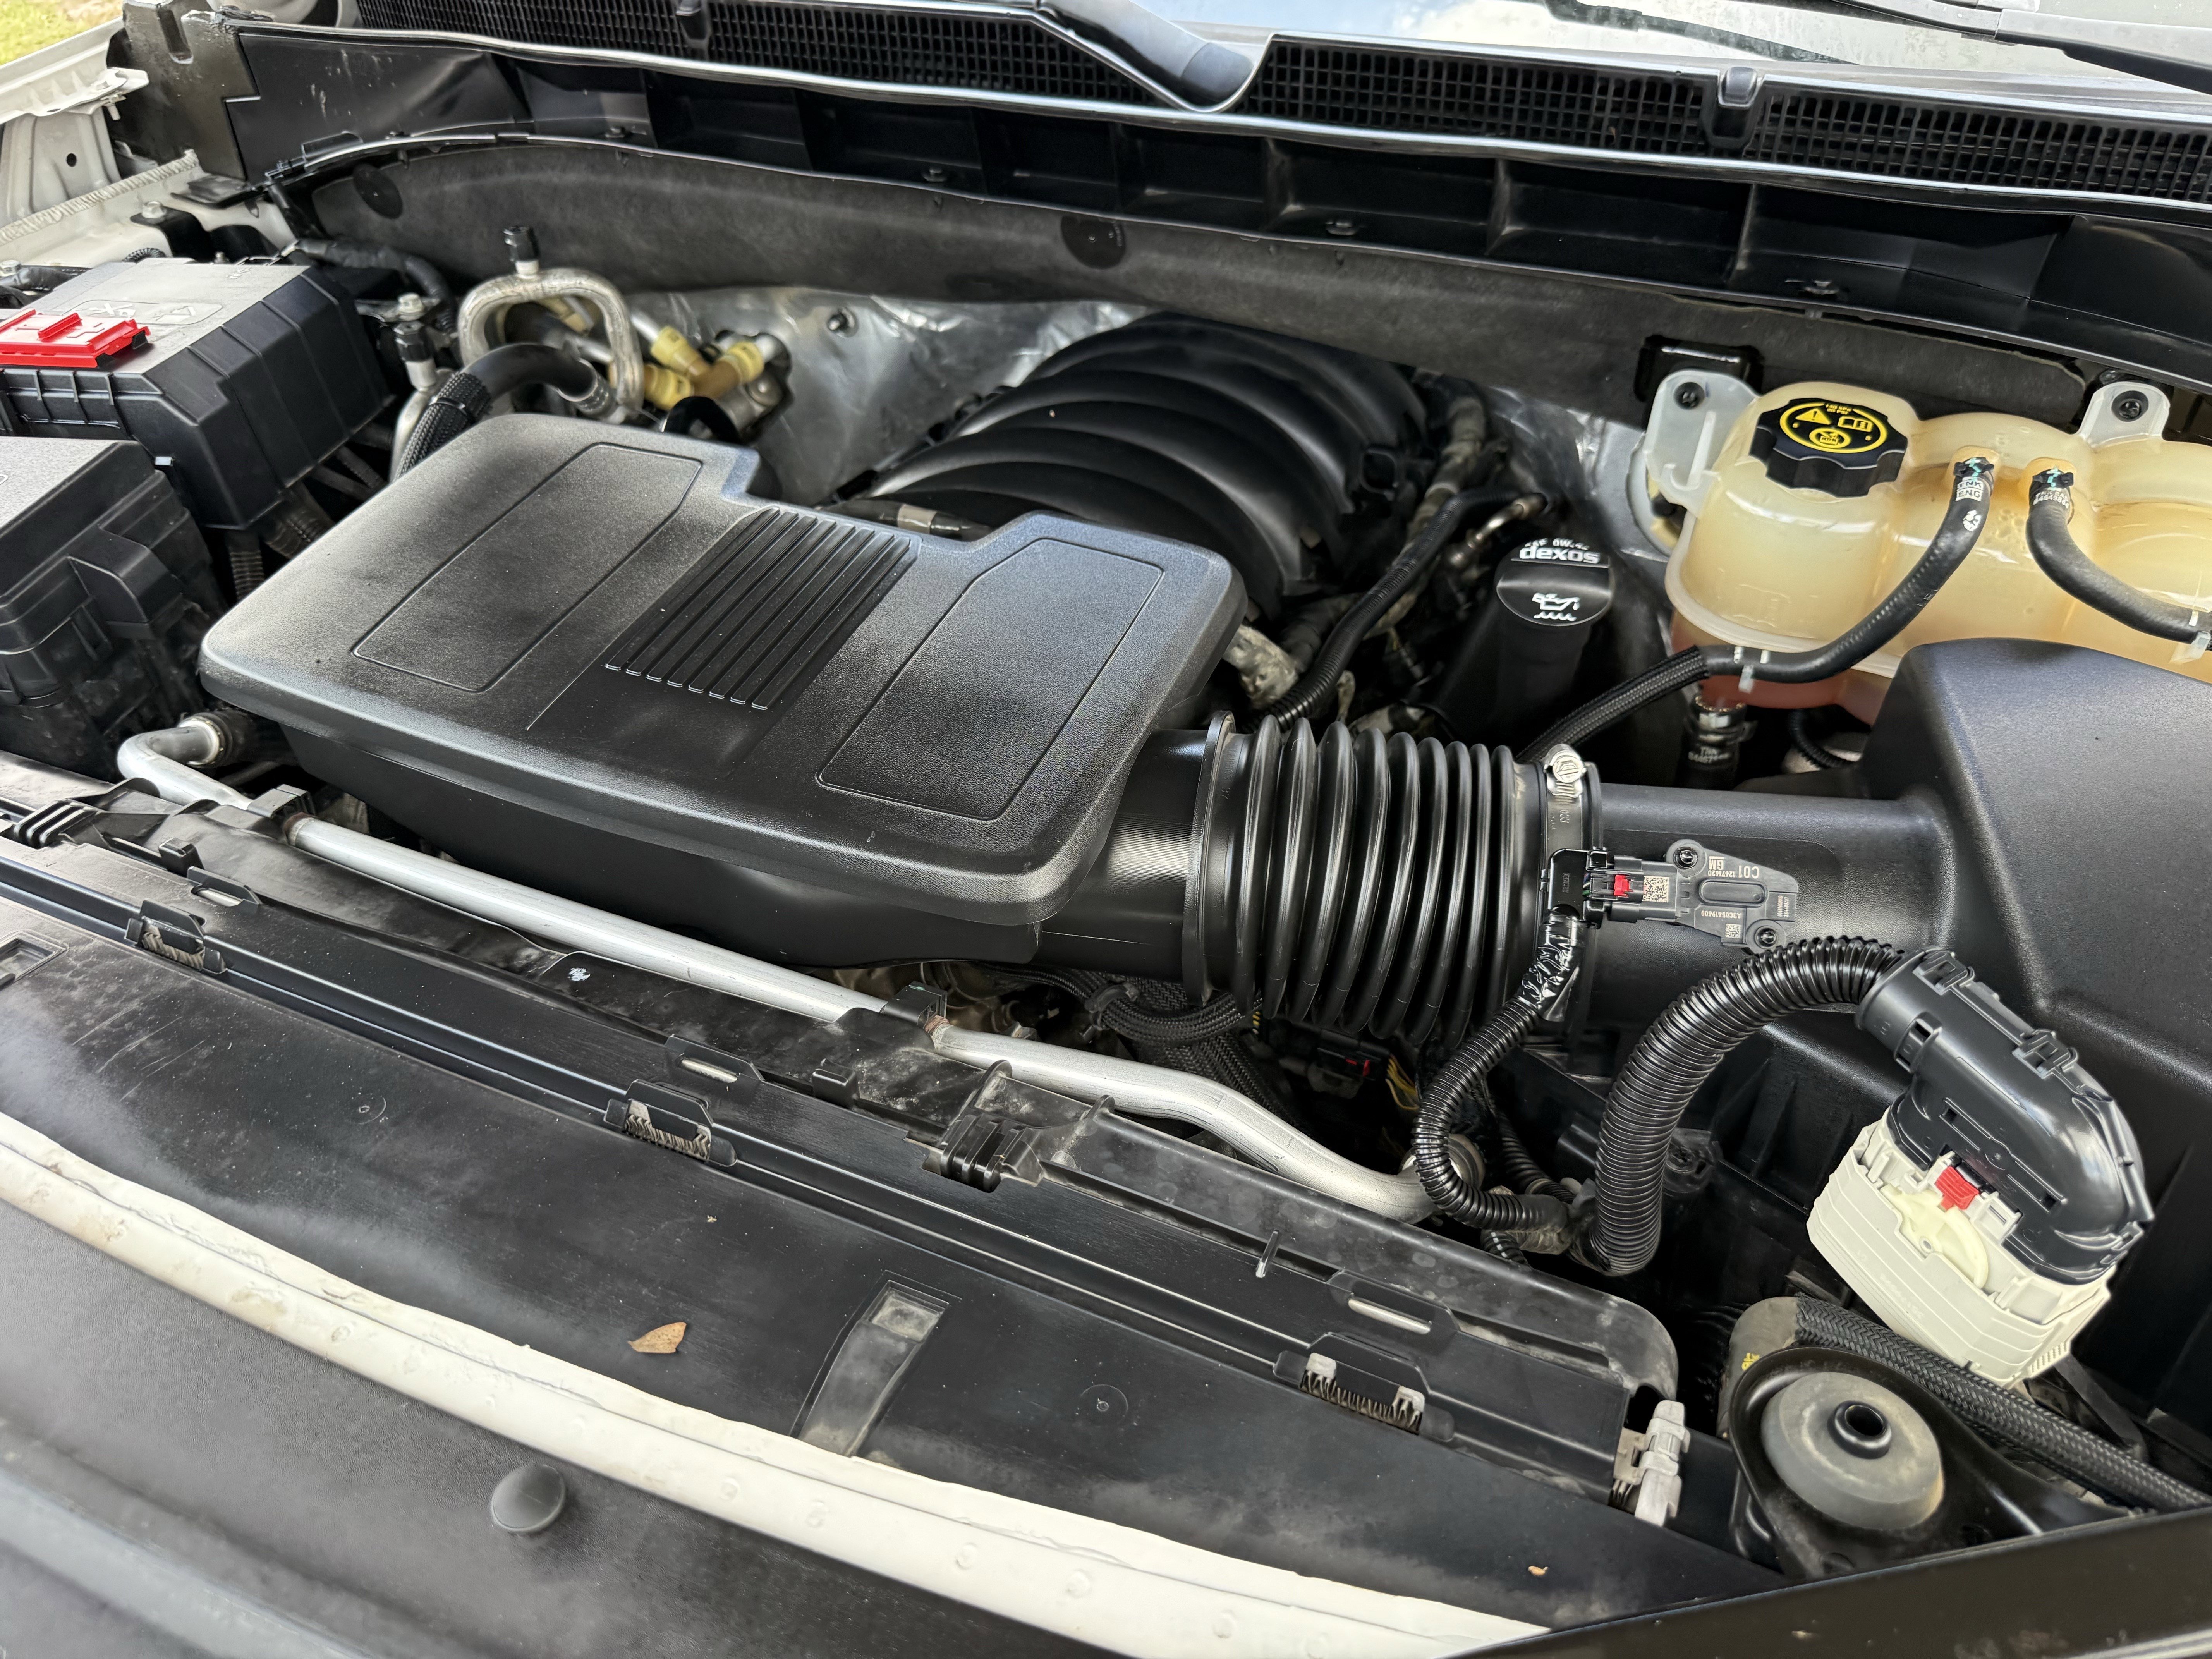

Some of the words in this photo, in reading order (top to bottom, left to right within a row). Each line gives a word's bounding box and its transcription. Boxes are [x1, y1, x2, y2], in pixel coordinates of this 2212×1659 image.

[1959, 489, 1980, 498] ENG
[1519, 546, 1601, 564] dexos
[1709, 859, 1724, 870] GM
